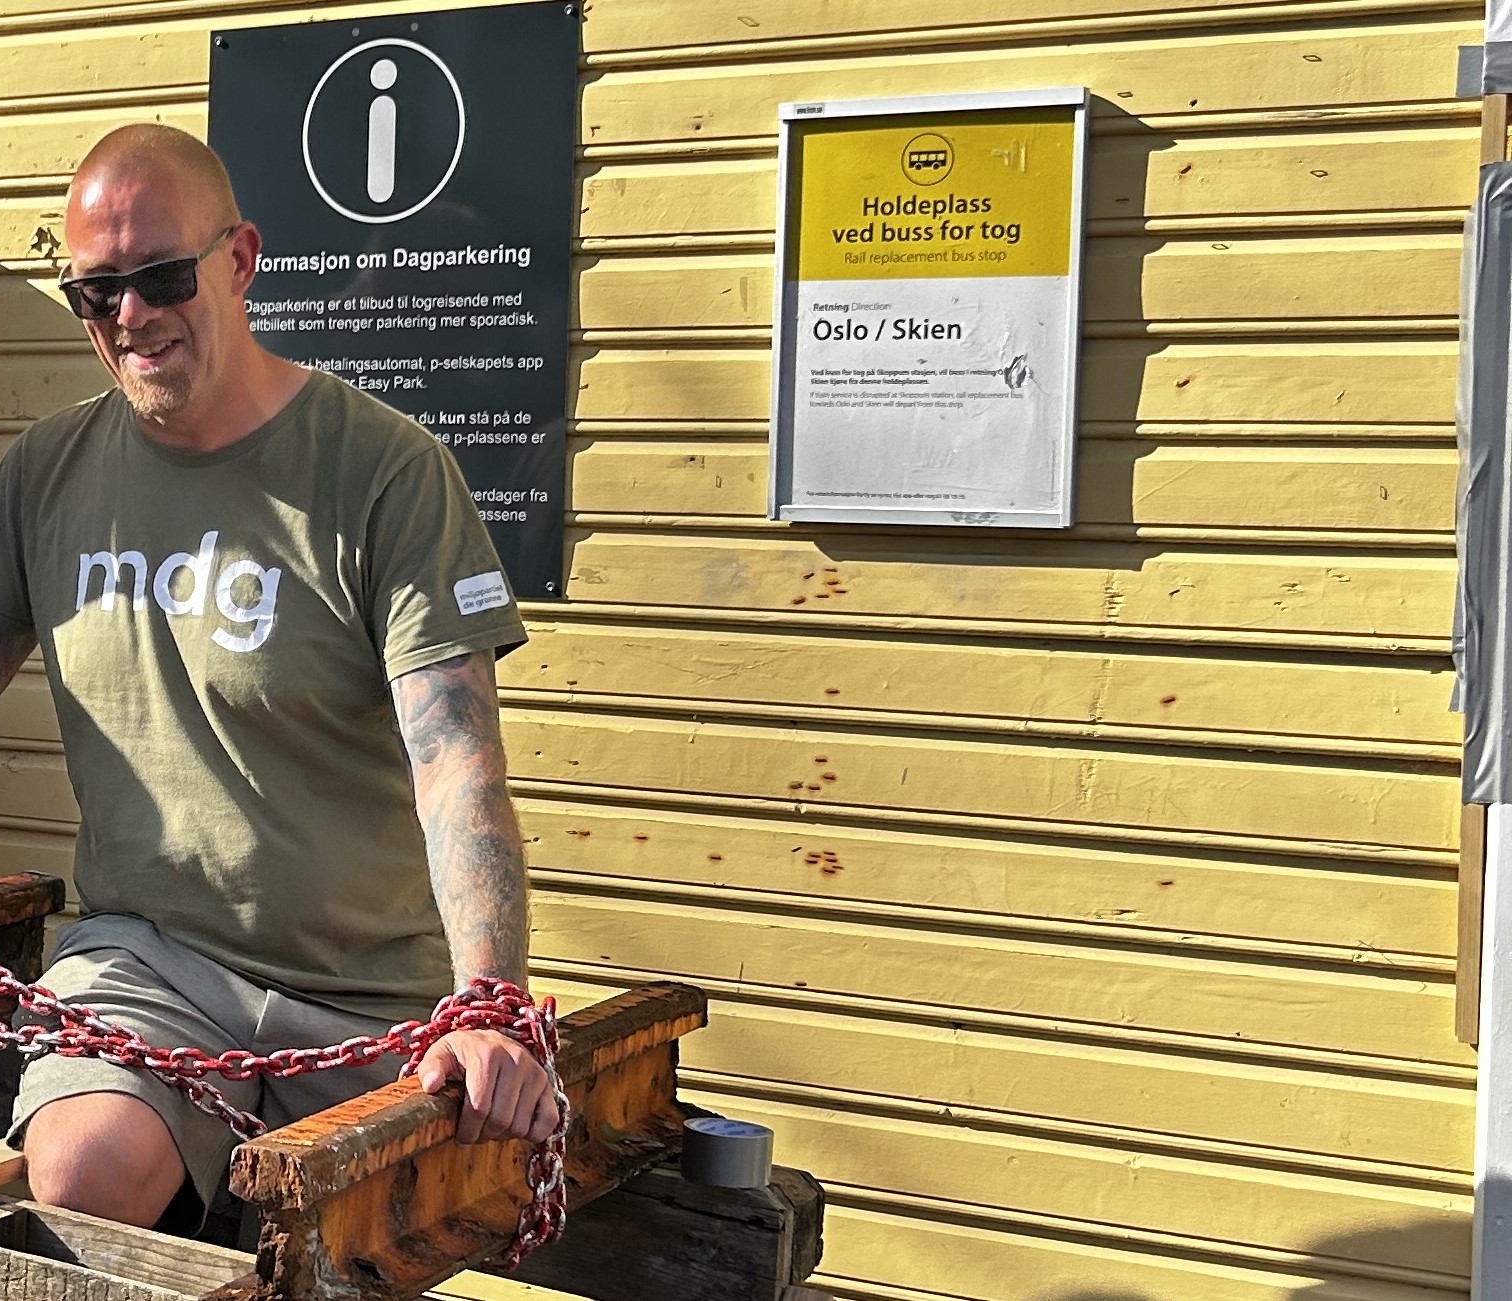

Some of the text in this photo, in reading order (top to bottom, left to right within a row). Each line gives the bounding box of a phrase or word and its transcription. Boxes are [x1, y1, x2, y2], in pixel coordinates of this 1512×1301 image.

[863, 194, 991, 219] Holdeplass
[832, 220, 1021, 244] ved buss for tog
[255, 244, 531, 275] formasjon om Dagparkering
[845, 249, 1006, 266] Rail replacement bus stop
[244, 292, 522, 316] Dagparkering er et tilbud til togreisende med
[249, 311, 538, 333] eltbillett som trenger parkering mer sporadisk.
[813, 318, 962, 341] Oslo / Skien
[315, 356, 426, 373] betalingsautomat,
[430, 355, 514, 372] p-selskapets
[518, 357, 543, 371] app
[358, 376, 390, 392] Easy
[394, 375, 427, 390] Park.
[419, 411, 435, 425] du
[439, 410, 465, 424] kun
[469, 410, 489, 424] stå
[493, 410, 510, 427] på
[514, 410, 532, 424] de
[435, 430, 547, 446] se p-plassene er
[470, 488, 548, 505] erdager fra
[479, 510, 527, 522] assene
[76, 530, 282, 653] mdg
